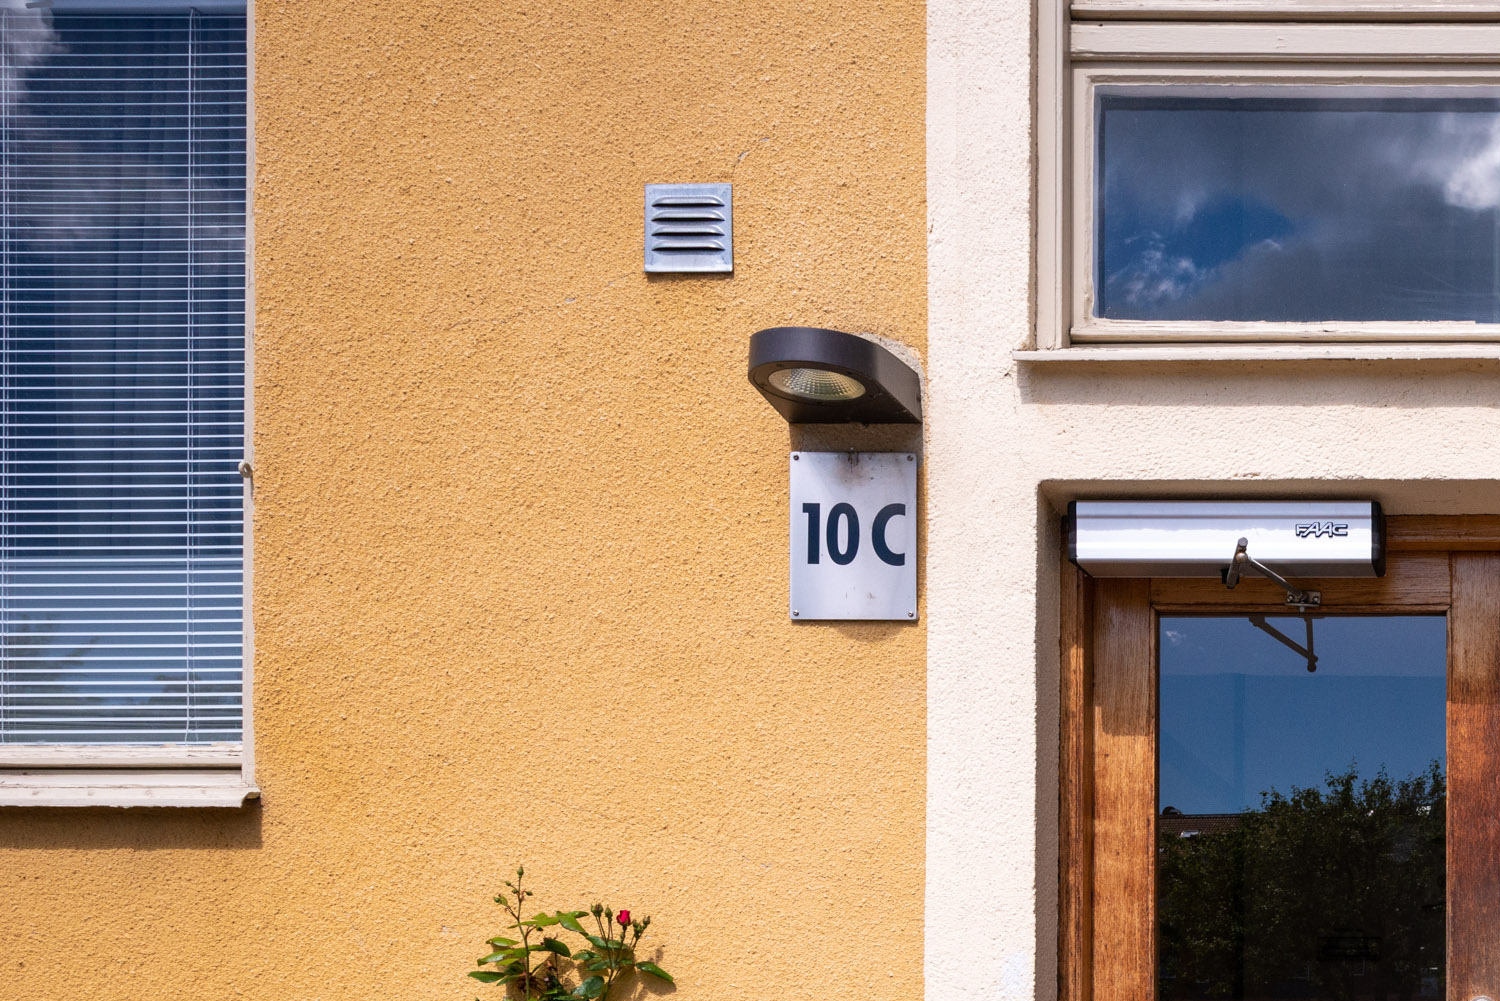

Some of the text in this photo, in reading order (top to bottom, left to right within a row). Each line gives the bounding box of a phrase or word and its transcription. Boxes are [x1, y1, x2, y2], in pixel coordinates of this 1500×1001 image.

[802, 502, 906, 566] 10 C
[1295, 521, 1348, 538] FAAC
